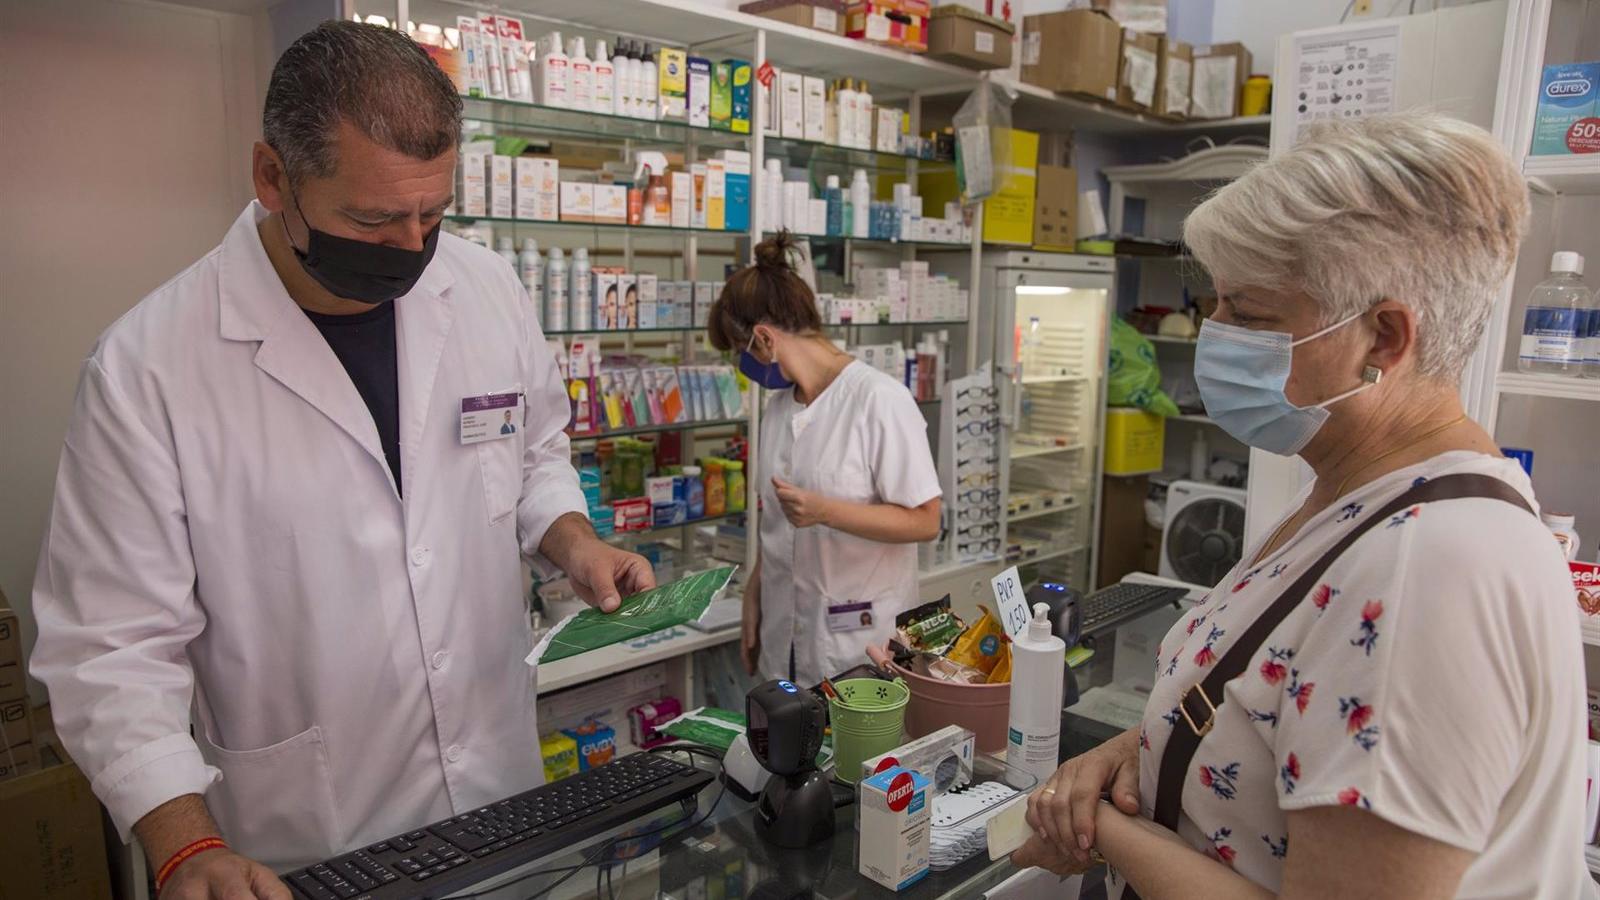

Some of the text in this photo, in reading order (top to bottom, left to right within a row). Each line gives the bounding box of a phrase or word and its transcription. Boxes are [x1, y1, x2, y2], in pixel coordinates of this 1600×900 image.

[1550, 82, 1586, 94] durex
[921, 613, 948, 631] NEO
[582, 737, 616, 755] evax
[888, 780, 914, 804] OFERTA
